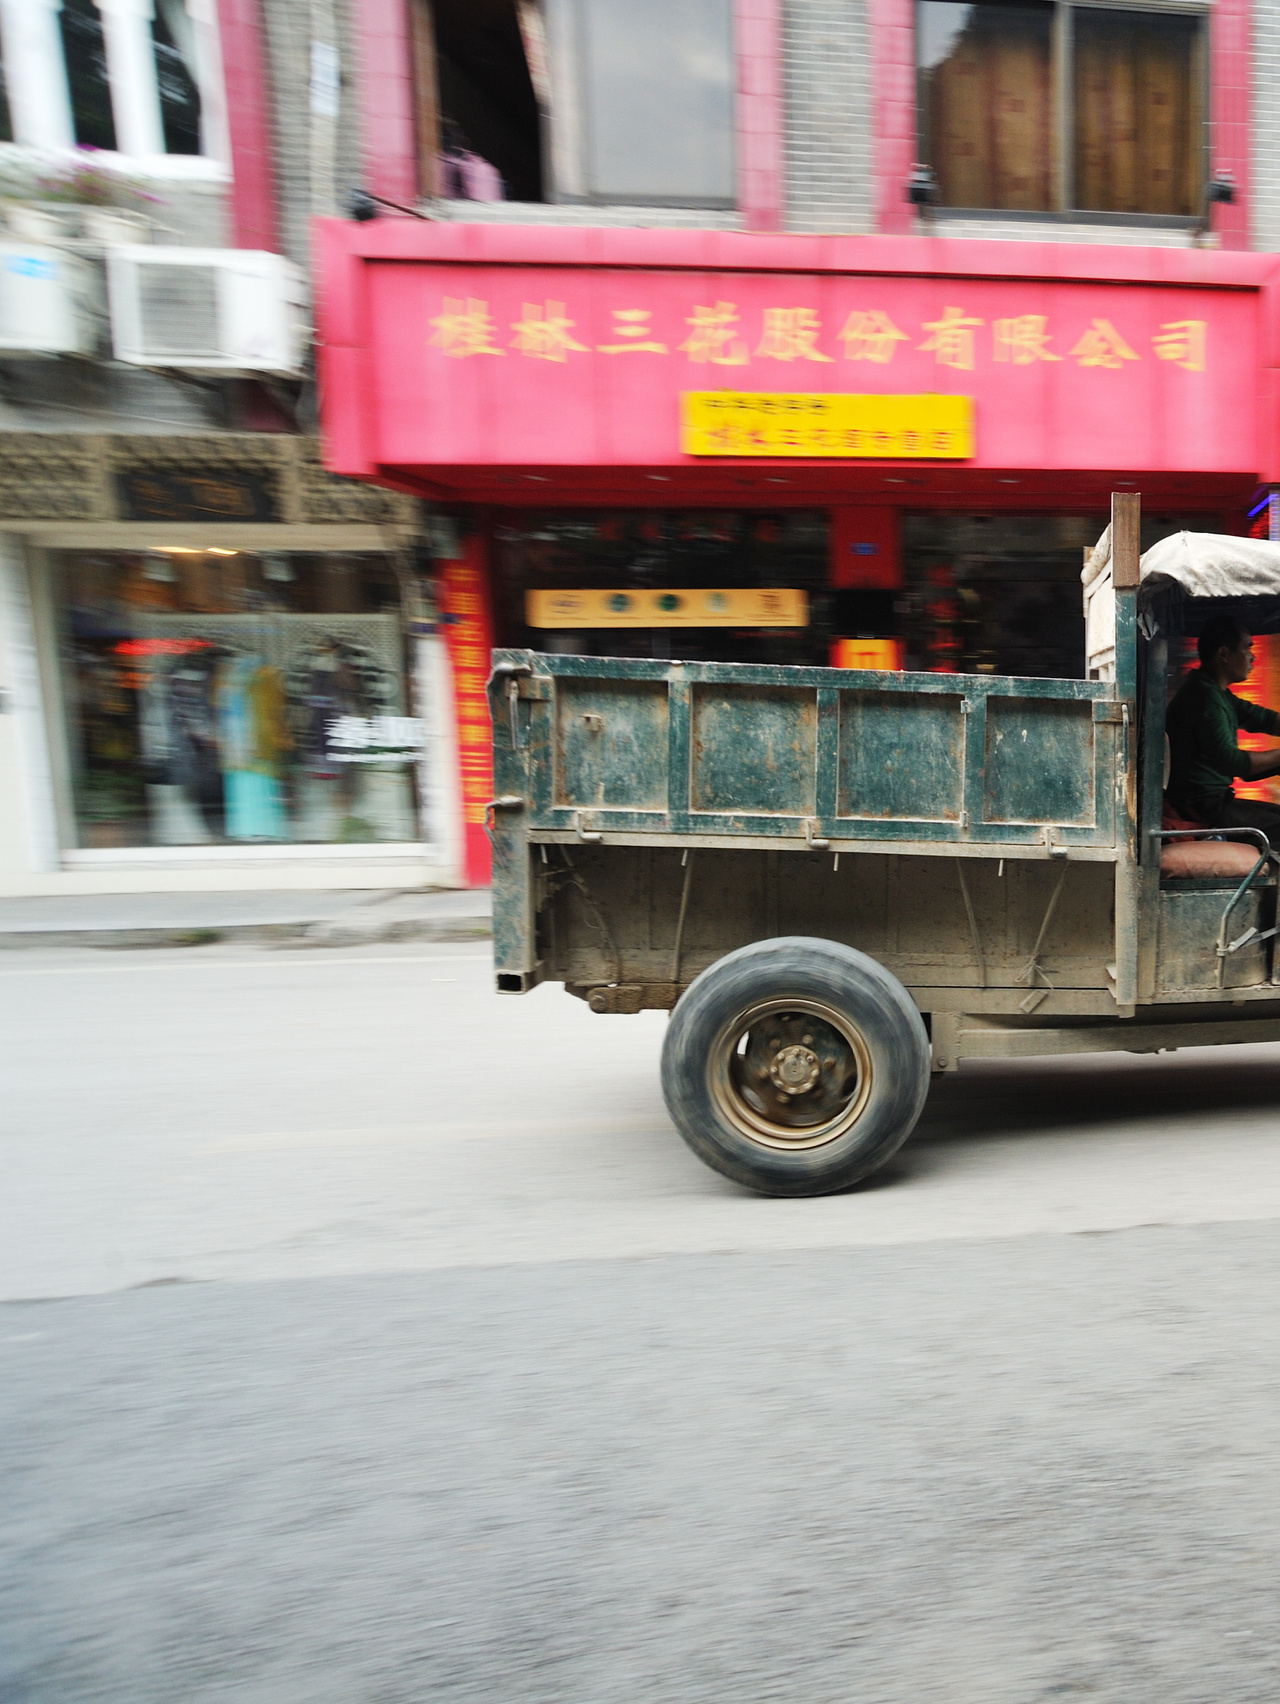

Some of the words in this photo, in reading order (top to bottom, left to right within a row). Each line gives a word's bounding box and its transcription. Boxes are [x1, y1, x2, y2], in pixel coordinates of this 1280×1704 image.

[427, 296, 1208, 371] 桂林三花股份有限公司
